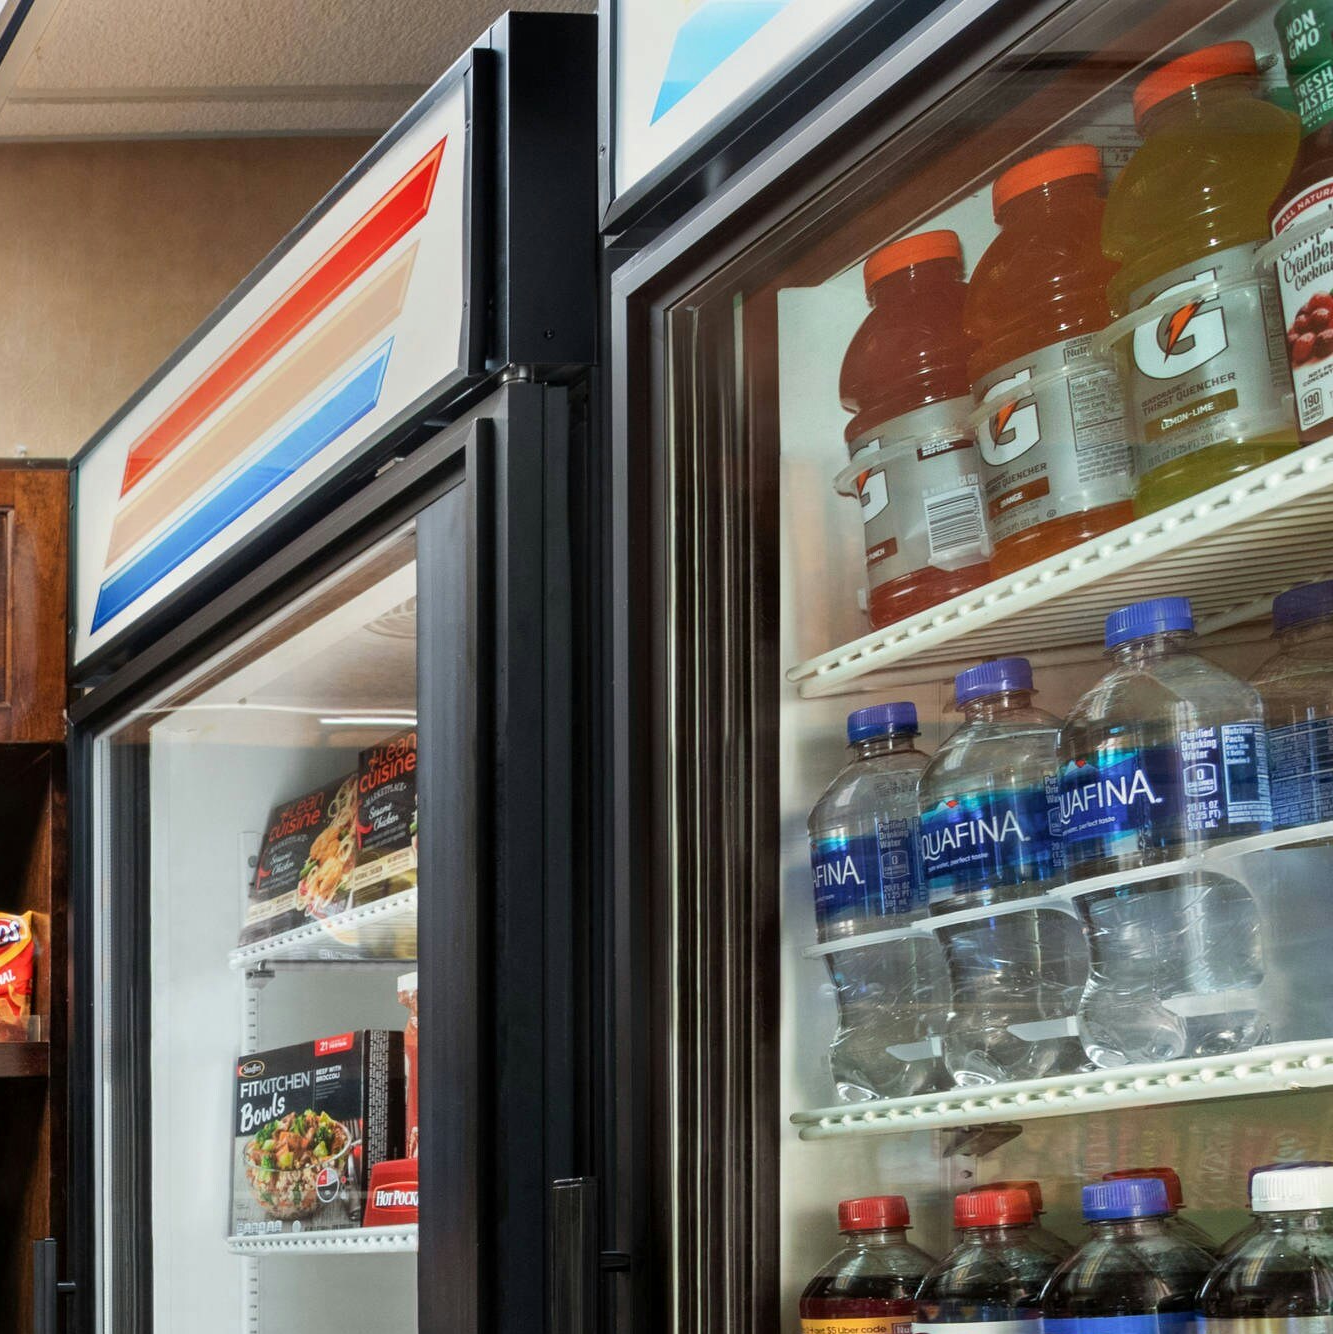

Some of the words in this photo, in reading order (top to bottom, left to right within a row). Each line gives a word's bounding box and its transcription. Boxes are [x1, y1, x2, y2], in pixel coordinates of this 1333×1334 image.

[1286, 9, 1317, 42] NON
[1289, 28, 1320, 60] GMO
[1281, 209, 1297, 225] ALL
[1133, 267, 1229, 380] G
[1143, 396, 1173, 416] THIRST
[1176, 372, 1237, 400] QUENCHER
[979, 367, 1041, 466] G
[1161, 402, 1215, 430] LEMON-LIME
[1001, 462, 1048, 489] QUENCHER
[1180, 728, 1214, 742] Purified
[1181, 738, 1217, 751] Drinking
[1225, 735, 1245, 744] Facts
[378, 732, 417, 767] Lean
[1182, 749, 1209, 762] Water
[359, 752, 417, 793] cuisine
[1196, 769, 1204, 781] 0
[1186, 803, 1198, 814] 20
[1199, 802, 1208, 812] FL
[1209, 800, 1219, 810] OZ
[268, 810, 321, 843] cuisine
[319, 1041, 328, 1052] 21
[315, 1067, 328, 1076] BEEF
[240, 1091, 286, 1133] Bowls
[826, 1325, 837, 1334] $5
[837, 1325, 859, 1334] Uber
[860, 1325, 887, 1334] code
